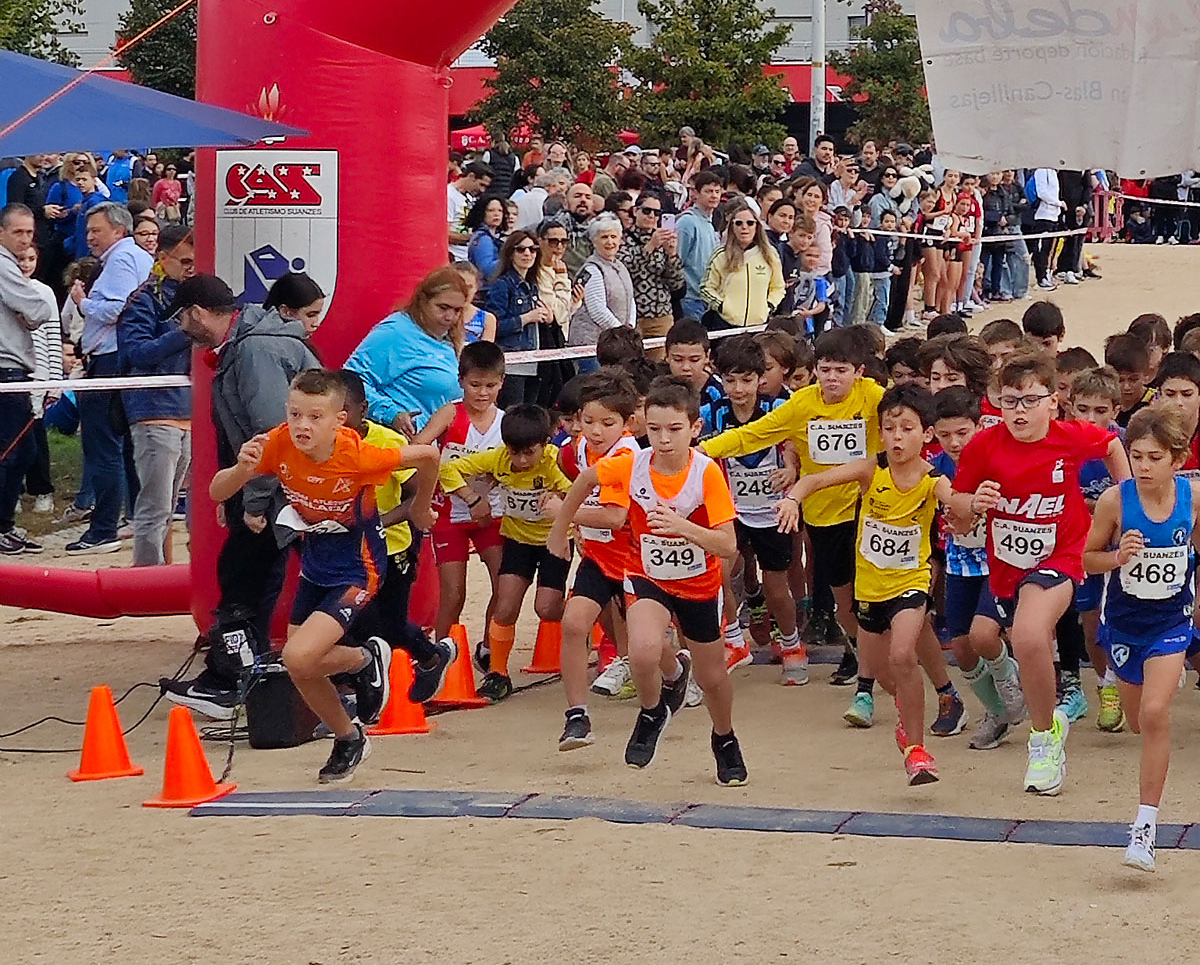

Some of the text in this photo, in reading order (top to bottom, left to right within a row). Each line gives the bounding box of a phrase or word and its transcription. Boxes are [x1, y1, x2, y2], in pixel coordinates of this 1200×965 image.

[817, 433, 857, 452] 676
[736, 479, 773, 497] 248
[882, 526, 919, 537] SUANZES
[993, 521, 1053, 534] C.A. SUANZES
[660, 539, 690, 547] SUAN
[869, 533, 911, 557] 684
[1000, 534, 1045, 556] 499
[650, 548, 694, 567] 349
[1143, 551, 1185, 560] SUANZES
[1128, 562, 1176, 584] 468
